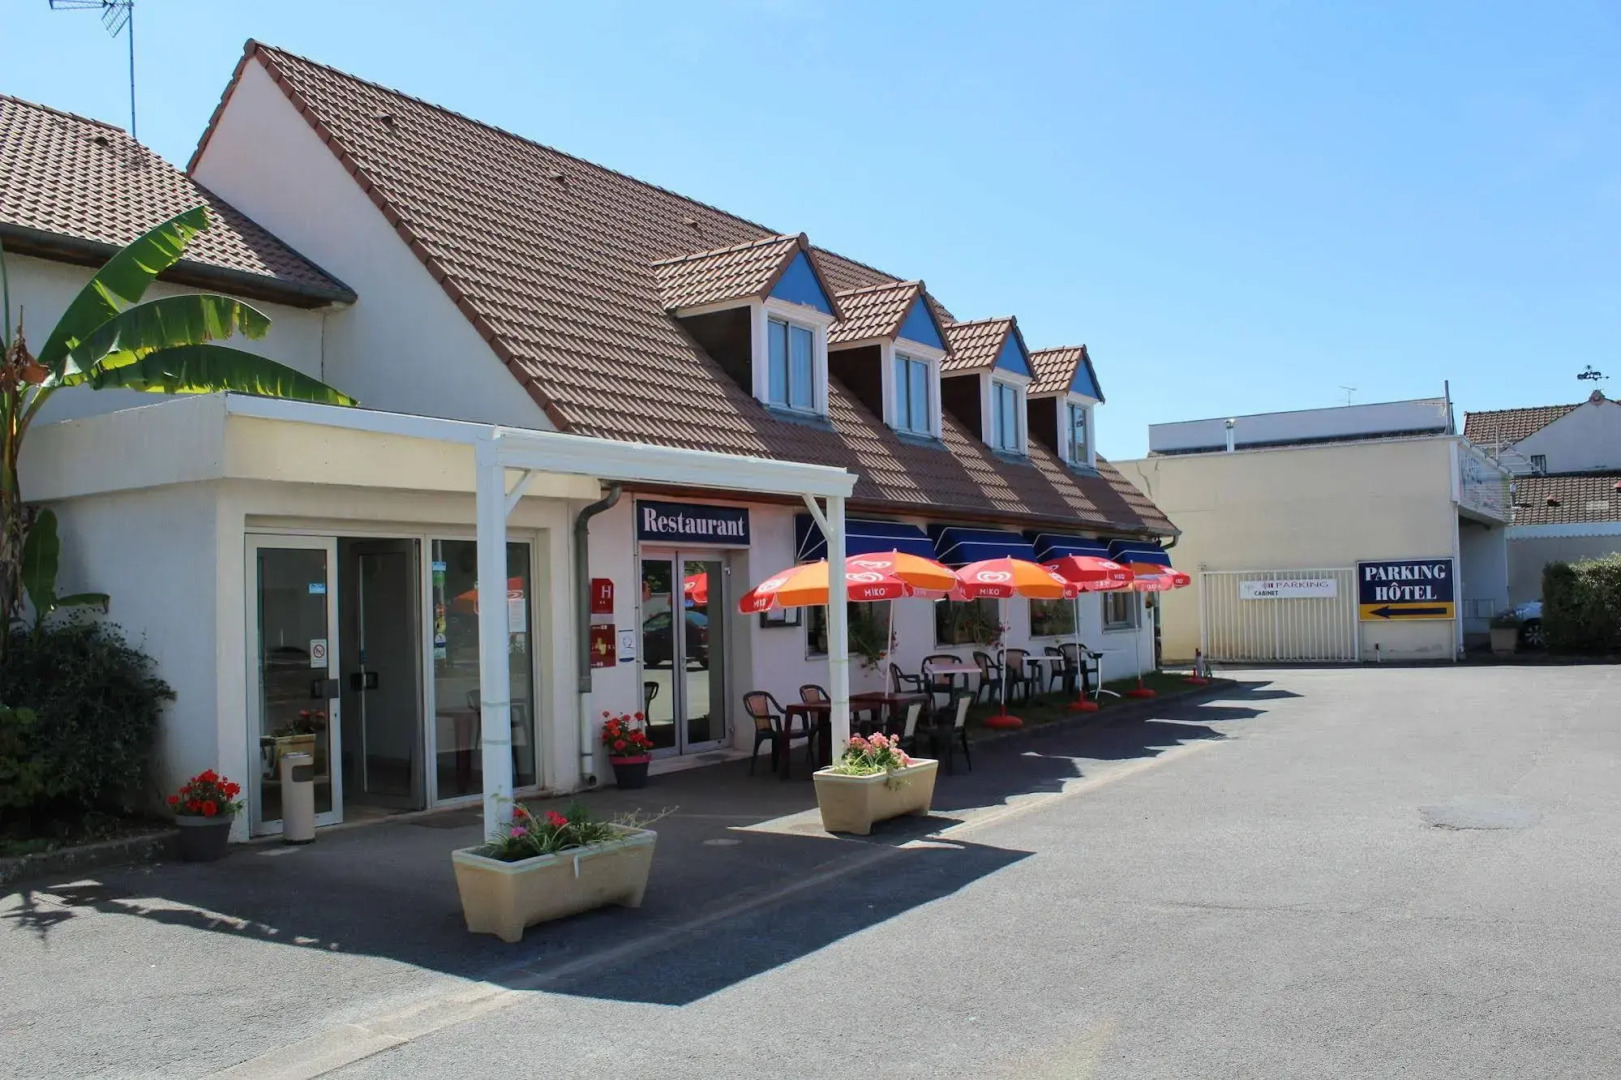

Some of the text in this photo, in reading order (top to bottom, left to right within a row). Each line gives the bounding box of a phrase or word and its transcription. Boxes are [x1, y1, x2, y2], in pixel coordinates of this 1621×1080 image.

[643, 507, 745, 536] Restaurant
[1365, 564, 1446, 581] PARKING
[601, 585, 611, 599] H
[864, 587, 885, 597] MIKO
[979, 588, 1000, 596] MIKO
[1375, 582, 1437, 600] HÔTEL
